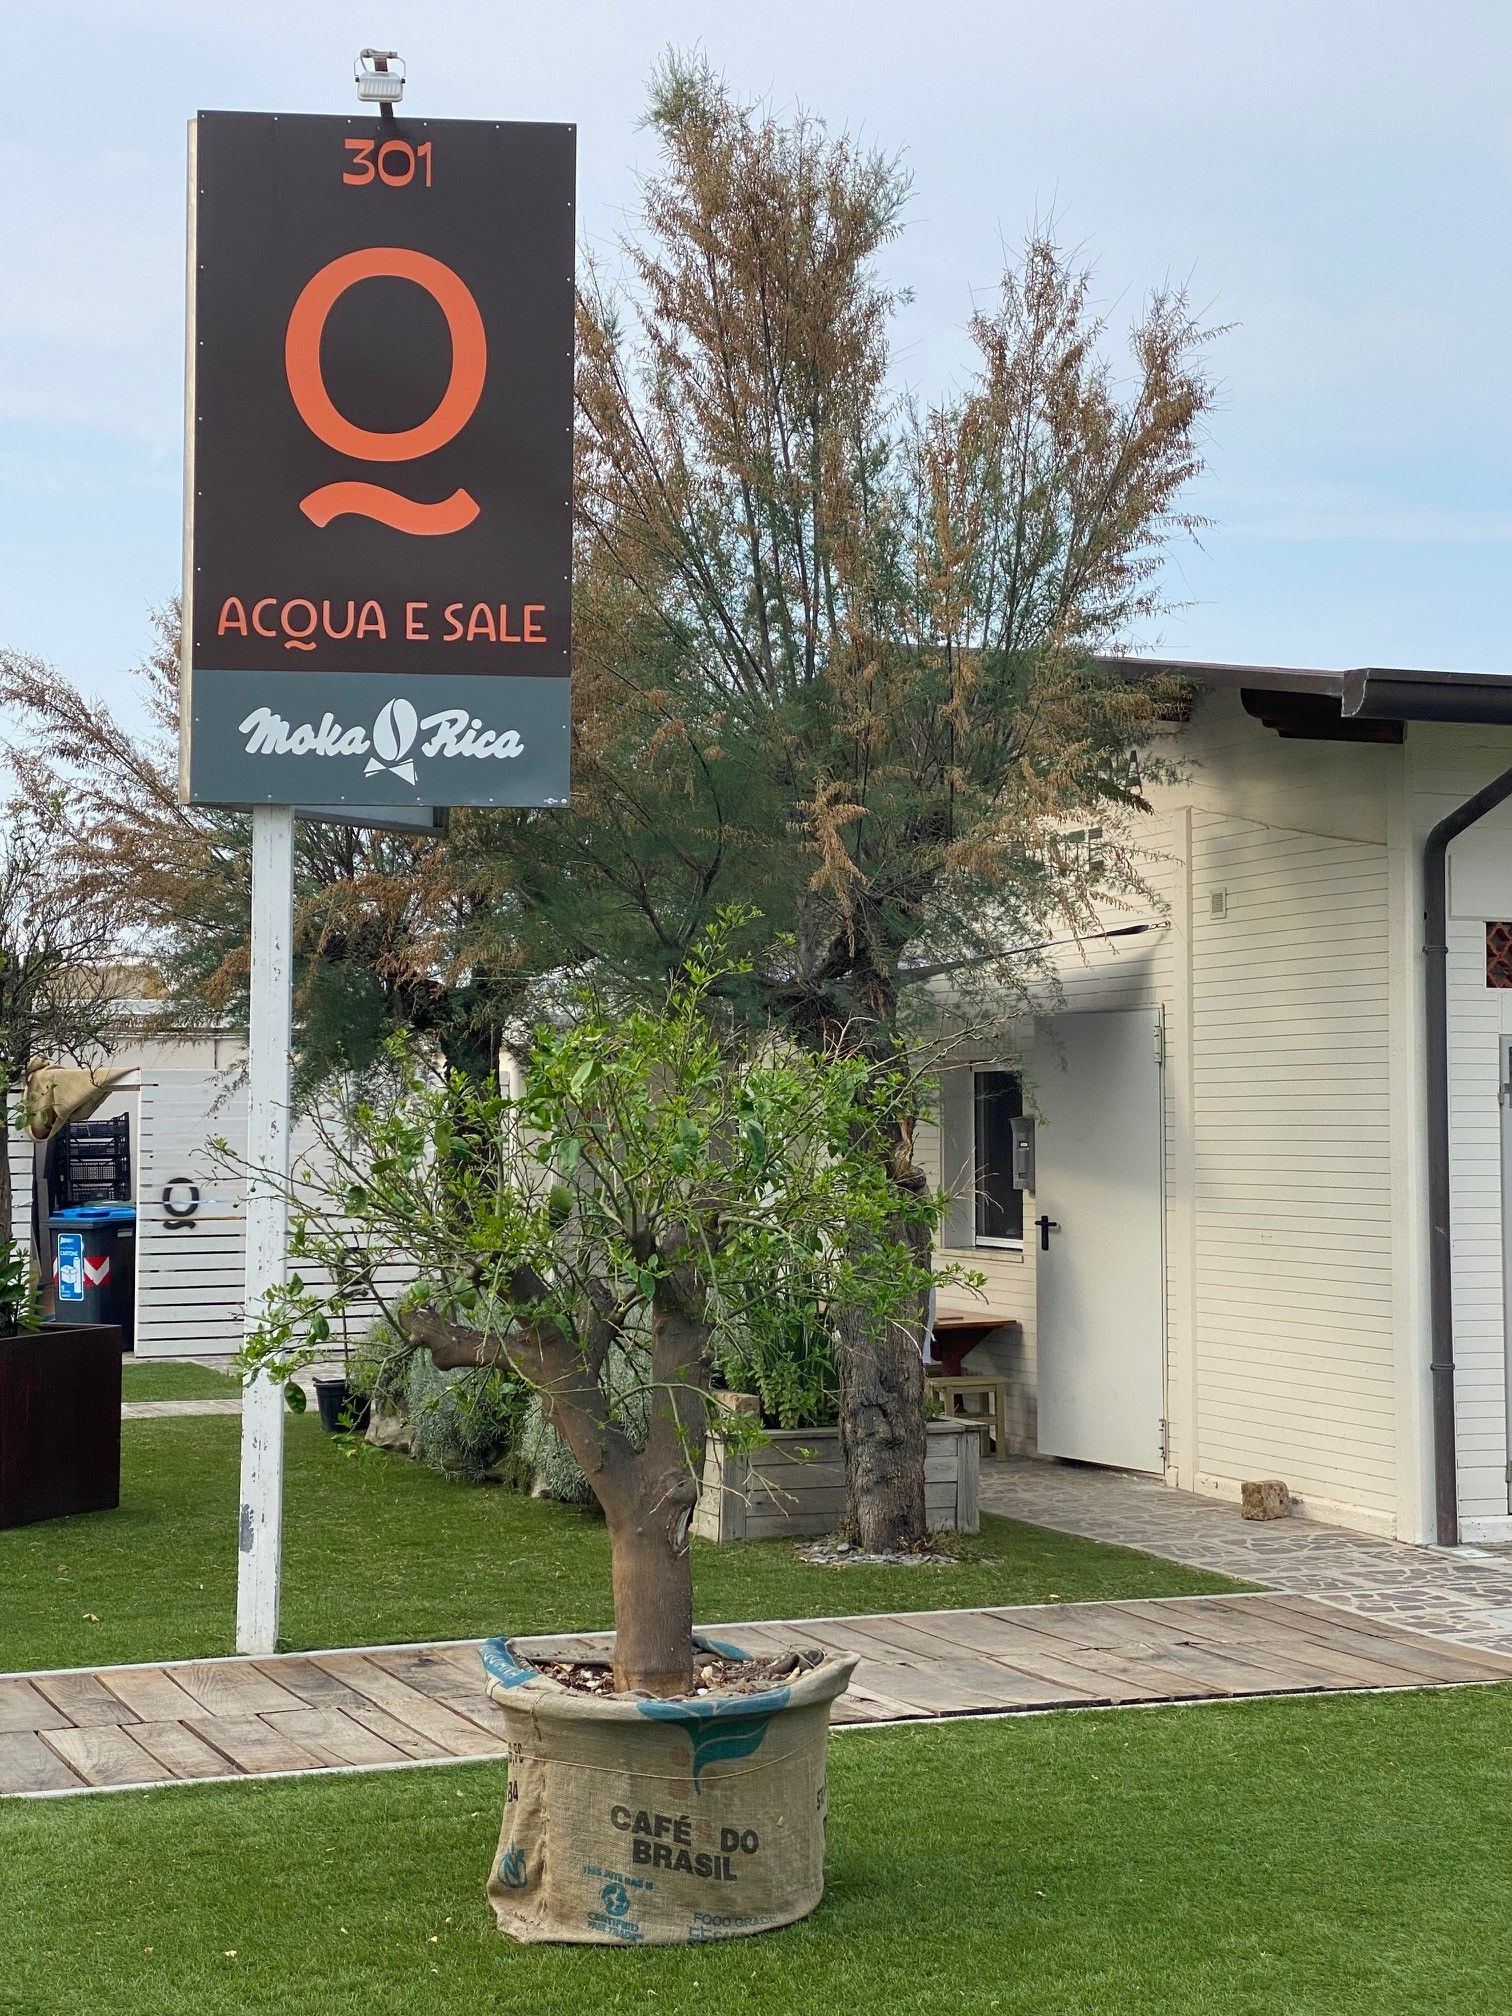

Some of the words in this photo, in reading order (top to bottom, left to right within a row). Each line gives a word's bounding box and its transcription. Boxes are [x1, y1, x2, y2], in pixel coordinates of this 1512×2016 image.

[342, 138, 433, 187] 301
[217, 596, 387, 652] ACQUA
[405, 601, 430, 641] E
[443, 602, 547, 643] SALE
[238, 706, 371, 757] Moka
[420, 708, 525, 759] Rica
[610, 1804, 692, 1847] CAFÉ
[720, 1827, 760, 1854] DO
[632, 1838, 738, 1882] BRASIL
